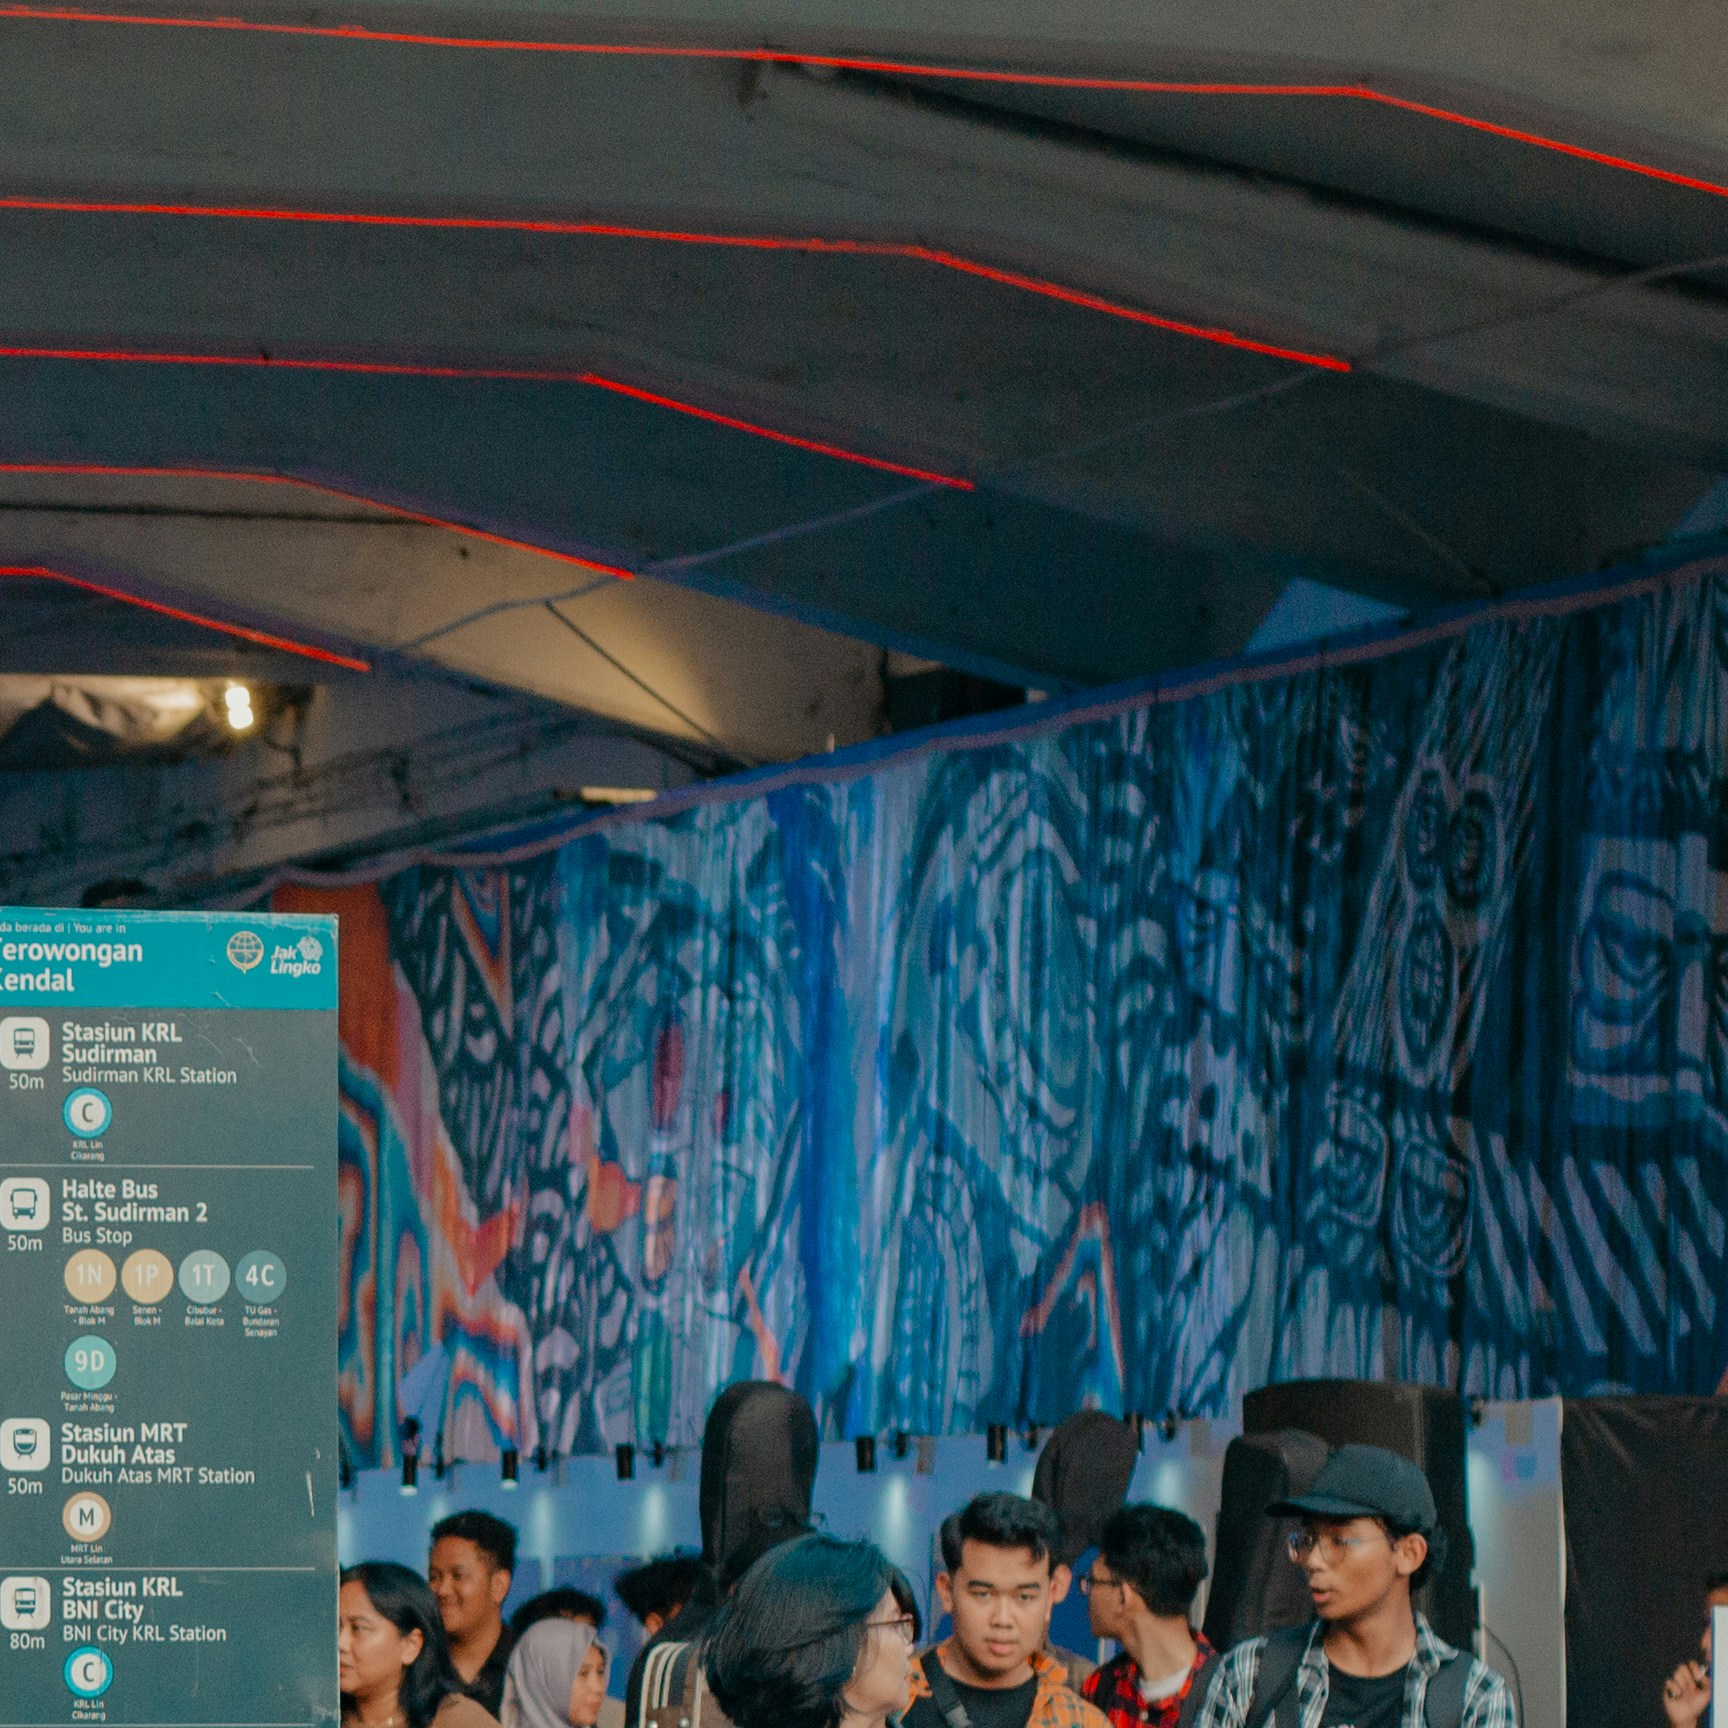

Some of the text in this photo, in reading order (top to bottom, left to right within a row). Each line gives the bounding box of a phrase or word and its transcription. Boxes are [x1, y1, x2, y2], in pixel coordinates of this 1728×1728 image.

[15, 922, 52, 933] berada
[55, 922, 64, 933] di
[74, 923, 92, 933] You
[96, 924, 112, 934] are
[116, 923, 126, 934] in
[271, 945, 297, 960] Jak
[270, 960, 321, 978] Lingko
[62, 1021, 183, 1042] Stasiun KRL
[62, 1044, 157, 1064] Sudirman
[9, 1074, 44, 1090] 50m
[62, 1066, 237, 1084] Sudirman KRL Station
[82, 1102, 94, 1123] C
[72, 1140, 103, 1149] KRL Lin
[71, 1151, 105, 1162] Cikarang
[62, 1180, 159, 1199] Halte Bus
[62, 1202, 208, 1223] St. Sudirman 2
[7, 1234, 43, 1251] 50m
[62, 1228, 133, 1247] Bus Stop
[76, 1263, 103, 1286] 1N
[134, 1263, 159, 1286] 1P
[191, 1264, 215, 1286] 1T
[245, 1264, 275, 1286] 4C
[64, 1305, 114, 1316] Tanah Abang
[132, 1306, 157, 1314] Senen
[257, 1306, 272, 1315] Gas
[78, 1317, 106, 1326] Blok M
[134, 1317, 161, 1326] Blok M
[184, 1317, 225, 1326] Balai Kota
[243, 1317, 279, 1326] Bundaran
[244, 1328, 278, 1339] Senayan
[74, 1350, 105, 1372] 9D
[60, 1392, 113, 1403] Pasar Minggu
[64, 1403, 115, 1414] Tanah Abang
[61, 1423, 188, 1443] Stasiun MRT
[62, 1445, 176, 1465] Dukuh Atas
[62, 1468, 255, 1485] Dukuh Atas MRT Station
[7, 1478, 43, 1495] 50m
[79, 1508, 94, 1526] M
[71, 1544, 103, 1553] MRT Lin
[61, 1555, 113, 1564] Utara Selatan
[63, 1577, 183, 1598] Stasiun KRL
[63, 1599, 144, 1623] BNI City
[10, 1633, 45, 1650] 80m
[63, 1624, 227, 1644] BNI City KRL Station
[83, 1661, 95, 1683] C
[74, 1700, 104, 1709] KRL Lin
[72, 1711, 106, 1721] Cikarang
